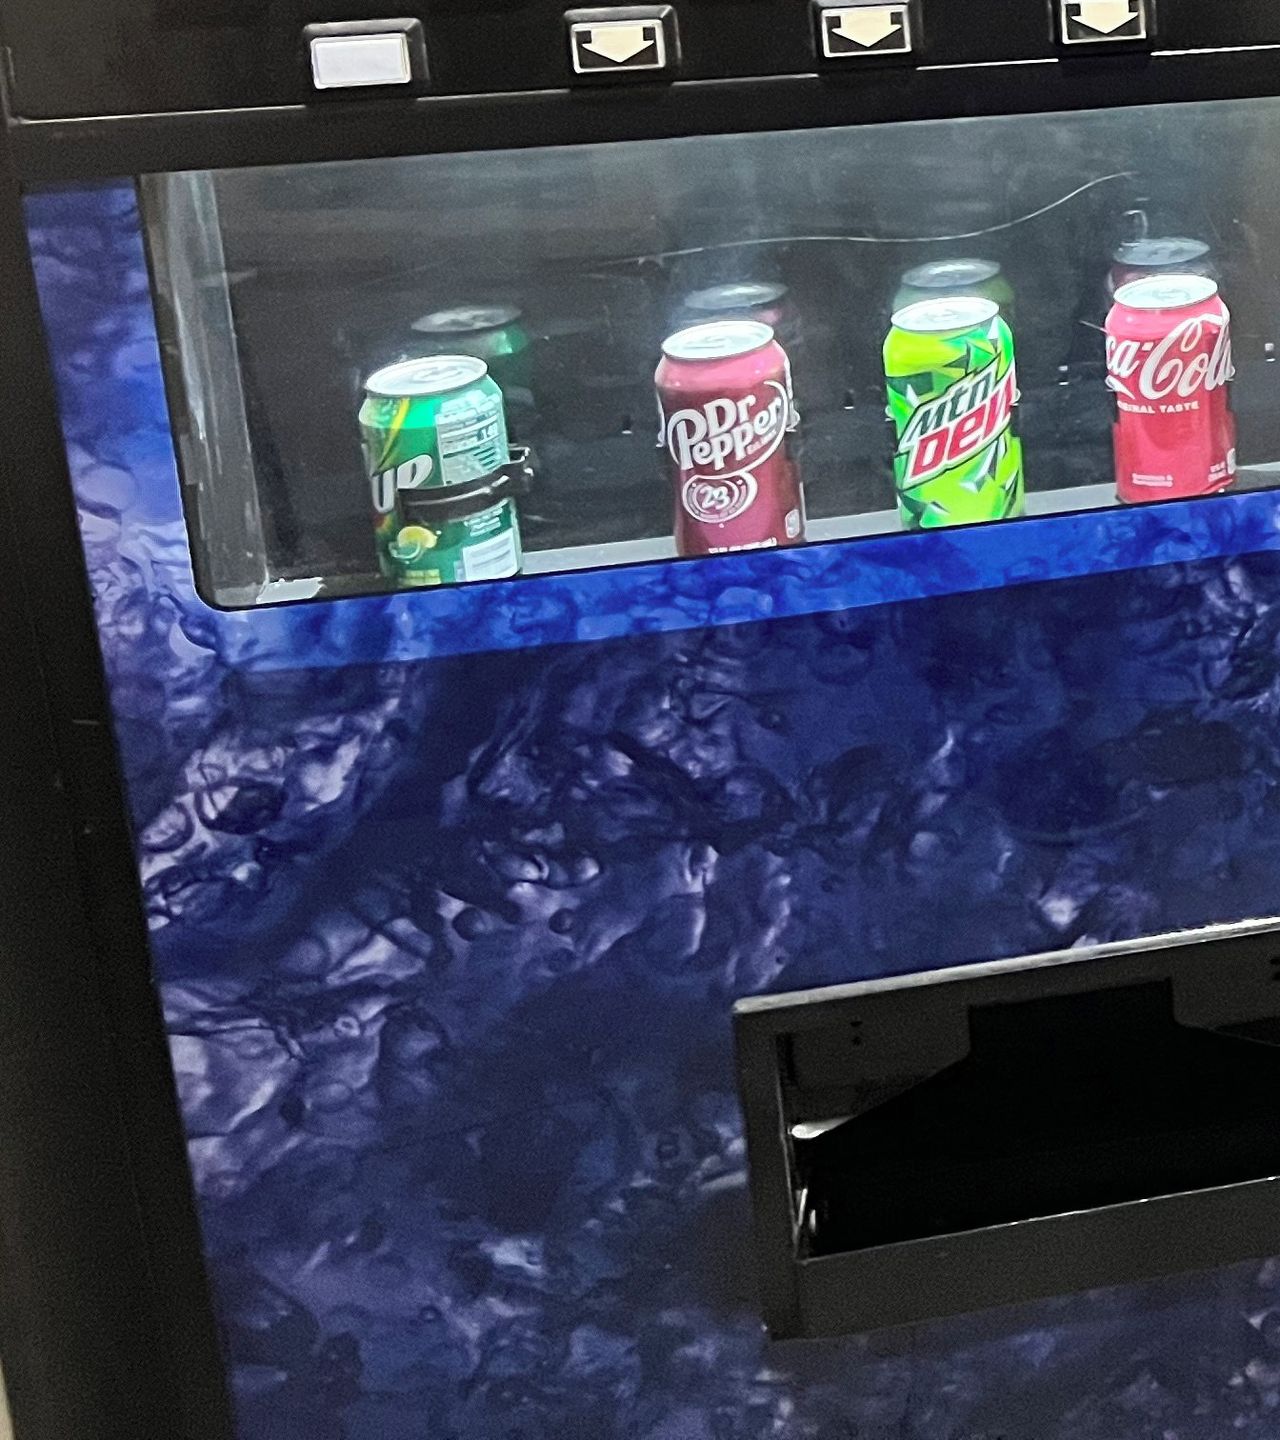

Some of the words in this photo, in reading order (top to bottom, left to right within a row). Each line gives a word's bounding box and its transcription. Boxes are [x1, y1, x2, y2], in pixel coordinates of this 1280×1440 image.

[668, 397, 782, 470] Pepper
[703, 394, 756, 437] Dr
[906, 371, 992, 442] Mtn
[1159, 401, 1200, 413] TASTE
